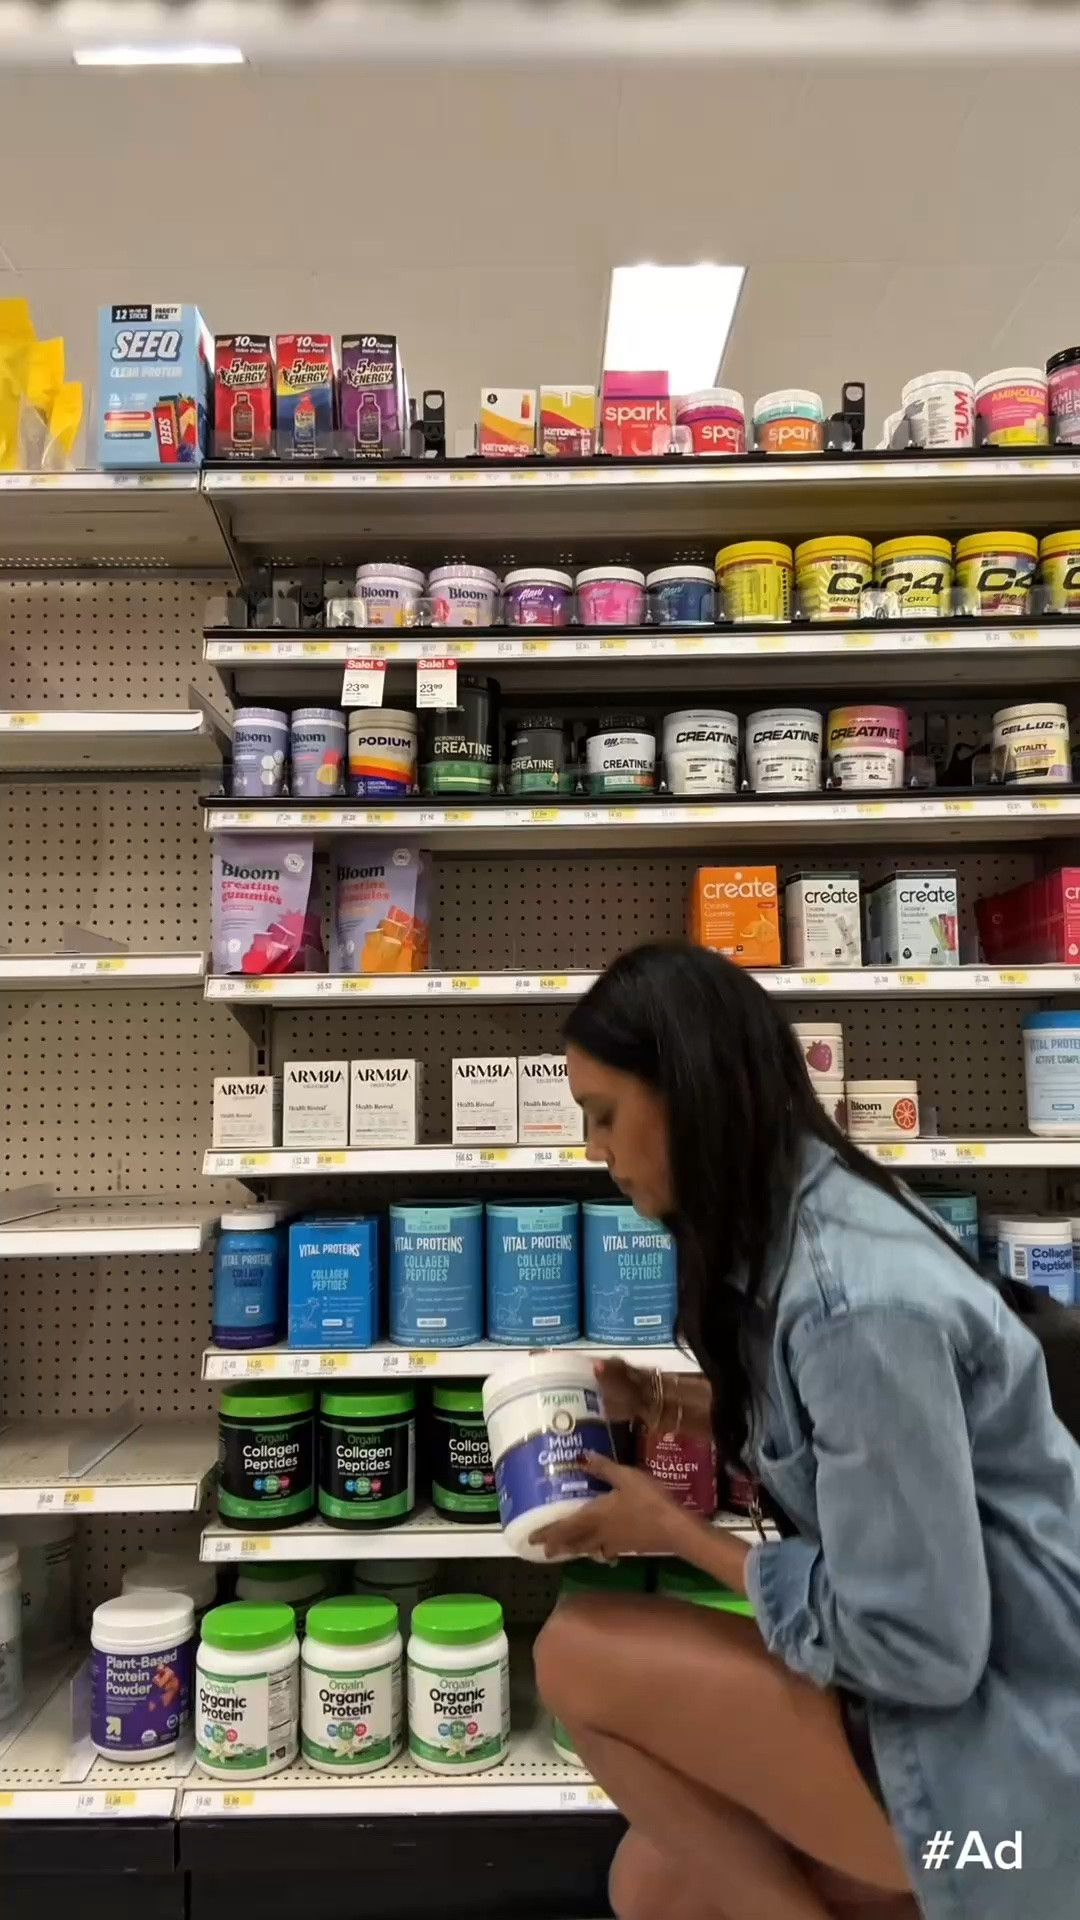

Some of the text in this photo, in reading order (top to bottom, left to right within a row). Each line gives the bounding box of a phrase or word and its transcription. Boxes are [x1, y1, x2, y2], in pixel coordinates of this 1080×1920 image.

[115, 309, 128, 320] 12
[111, 329, 183, 361] SEEQ
[234, 336, 250, 347] 10
[296, 336, 312, 347] 10
[361, 337, 377, 347] 10
[226, 370, 266, 385] ENERGY
[288, 370, 329, 385] ENERGY
[354, 372, 393, 385] ENERGY
[605, 401, 668, 426] spark
[954, 390, 971, 441] BUM
[158, 417, 174, 445] SEEQ
[361, 586, 400, 599] Bloom
[448, 586, 489, 600] Bloom
[347, 660, 374, 669] Sale!
[419, 660, 446, 669] Sale!
[235, 731, 272, 744] Bloom
[292, 732, 326, 743] Bloom
[358, 736, 412, 748] PODIUM
[676, 730, 738, 746] CREATINE
[752, 729, 819, 744] CREATINE
[433, 741, 492, 757] CREATINE
[1013, 743, 1048, 753] VITALITY
[511, 759, 554, 771] CREATINE
[603, 759, 648, 770] CREATINE
[221, 860, 280, 881] Bloom
[336, 864, 385, 881] Bloom
[221, 881, 280, 893] creatine
[703, 876, 777, 899] create
[899, 886, 955, 903] create
[221, 891, 283, 906] gummies
[804, 888, 858, 904] create
[850, 1101, 882, 1111] Bloom
[299, 1243, 361, 1258] VITAL PROTEINS
[394, 1236, 463, 1254] VITAL PROTEINS
[502, 1234, 573, 1252] VITAL PROTEINS
[602, 1234, 671, 1252] VITAL PROTEINS
[404, 1253, 450, 1268] COLLAGEN
[516, 1252, 563, 1267] COLLAGEN
[617, 1251, 664, 1267] COLLAGEN
[311, 1269, 349, 1280] COLLAGEN
[405, 1268, 448, 1282] PEPTIDES
[518, 1267, 561, 1281] PEPTIDES
[619, 1266, 662, 1280] PEPTIDES
[312, 1280, 348, 1292] PEPTIDES
[254, 1432, 289, 1447] Orgain
[347, 1433, 381, 1448] Orgain
[448, 1438, 489, 1453] Collag
[548, 1432, 583, 1450] Multi
[242, 1442, 300, 1460] Collagen
[336, 1445, 393, 1461] Collagen
[243, 1455, 299, 1473] Peptides
[337, 1457, 391, 1473] Peptides
[646, 1457, 699, 1472] COLLAGEN
[651, 1470, 689, 1481] PROTEIN
[105, 1650, 178, 1669] Plant-Based
[105, 1668, 151, 1683] Protein
[105, 1683, 153, 1696] Powder
[204, 1680, 236, 1695] Orgain
[328, 1679, 364, 1693] Orgain
[439, 1678, 475, 1692] Orgain
[199, 1688, 248, 1709] Organic
[318, 1688, 376, 1707] Organic
[429, 1687, 486, 1706] Organic
[201, 1702, 244, 1722] Protein
[322, 1702, 372, 1718] Protein
[433, 1701, 483, 1717] Protein
